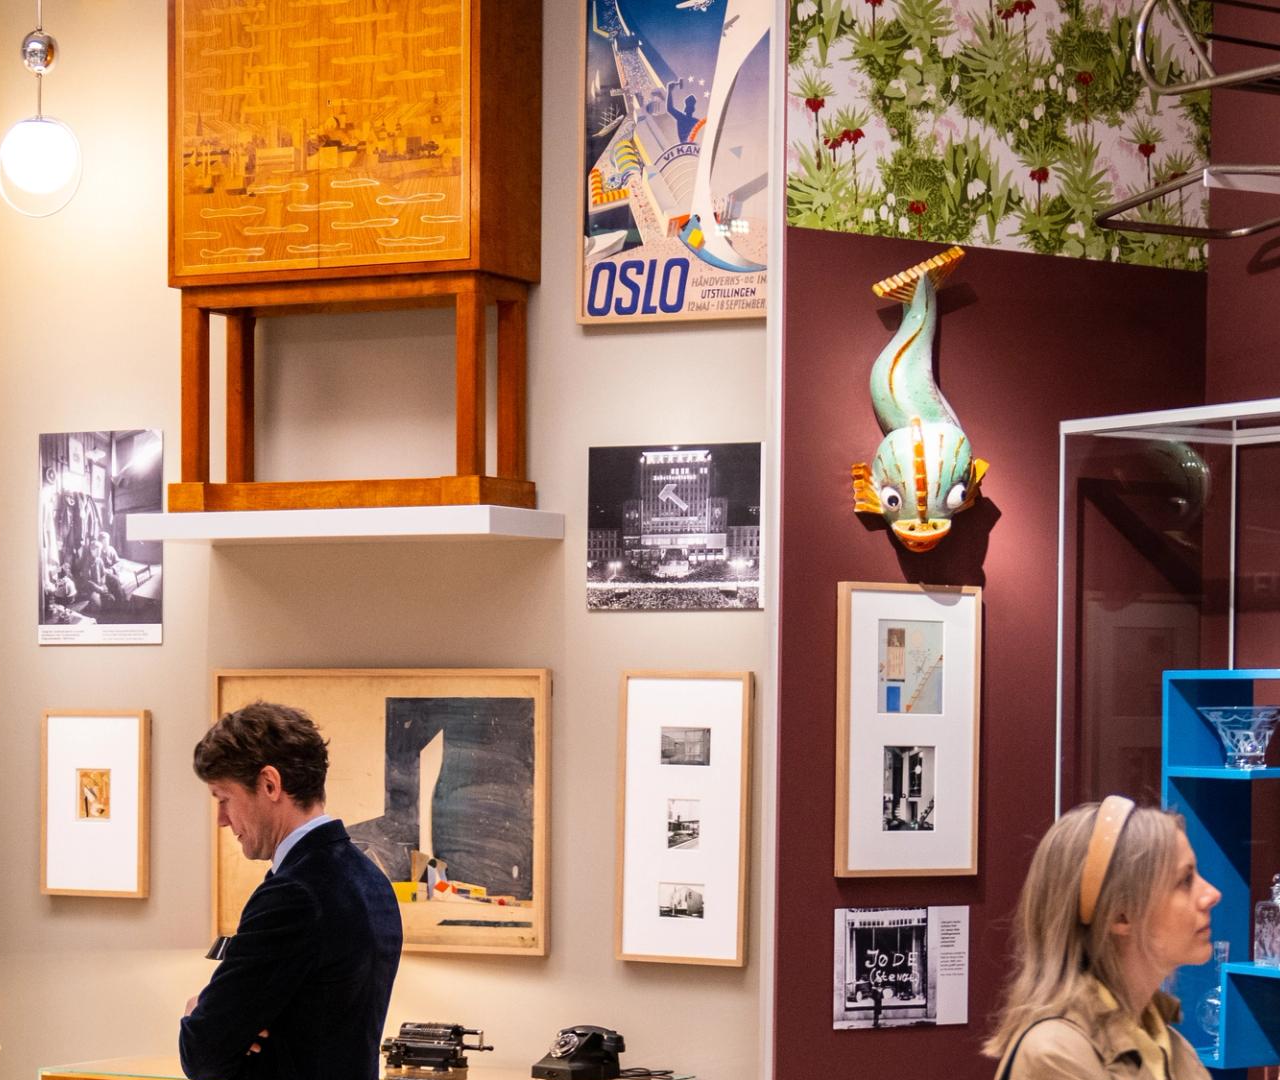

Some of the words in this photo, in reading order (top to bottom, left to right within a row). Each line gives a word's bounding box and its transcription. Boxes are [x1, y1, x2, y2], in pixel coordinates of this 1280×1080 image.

[663, 151, 674, 161] VI
[676, 146, 700, 154] KAN
[587, 258, 690, 316] OSLO
[701, 287, 756, 299] UTSTILLINGEN
